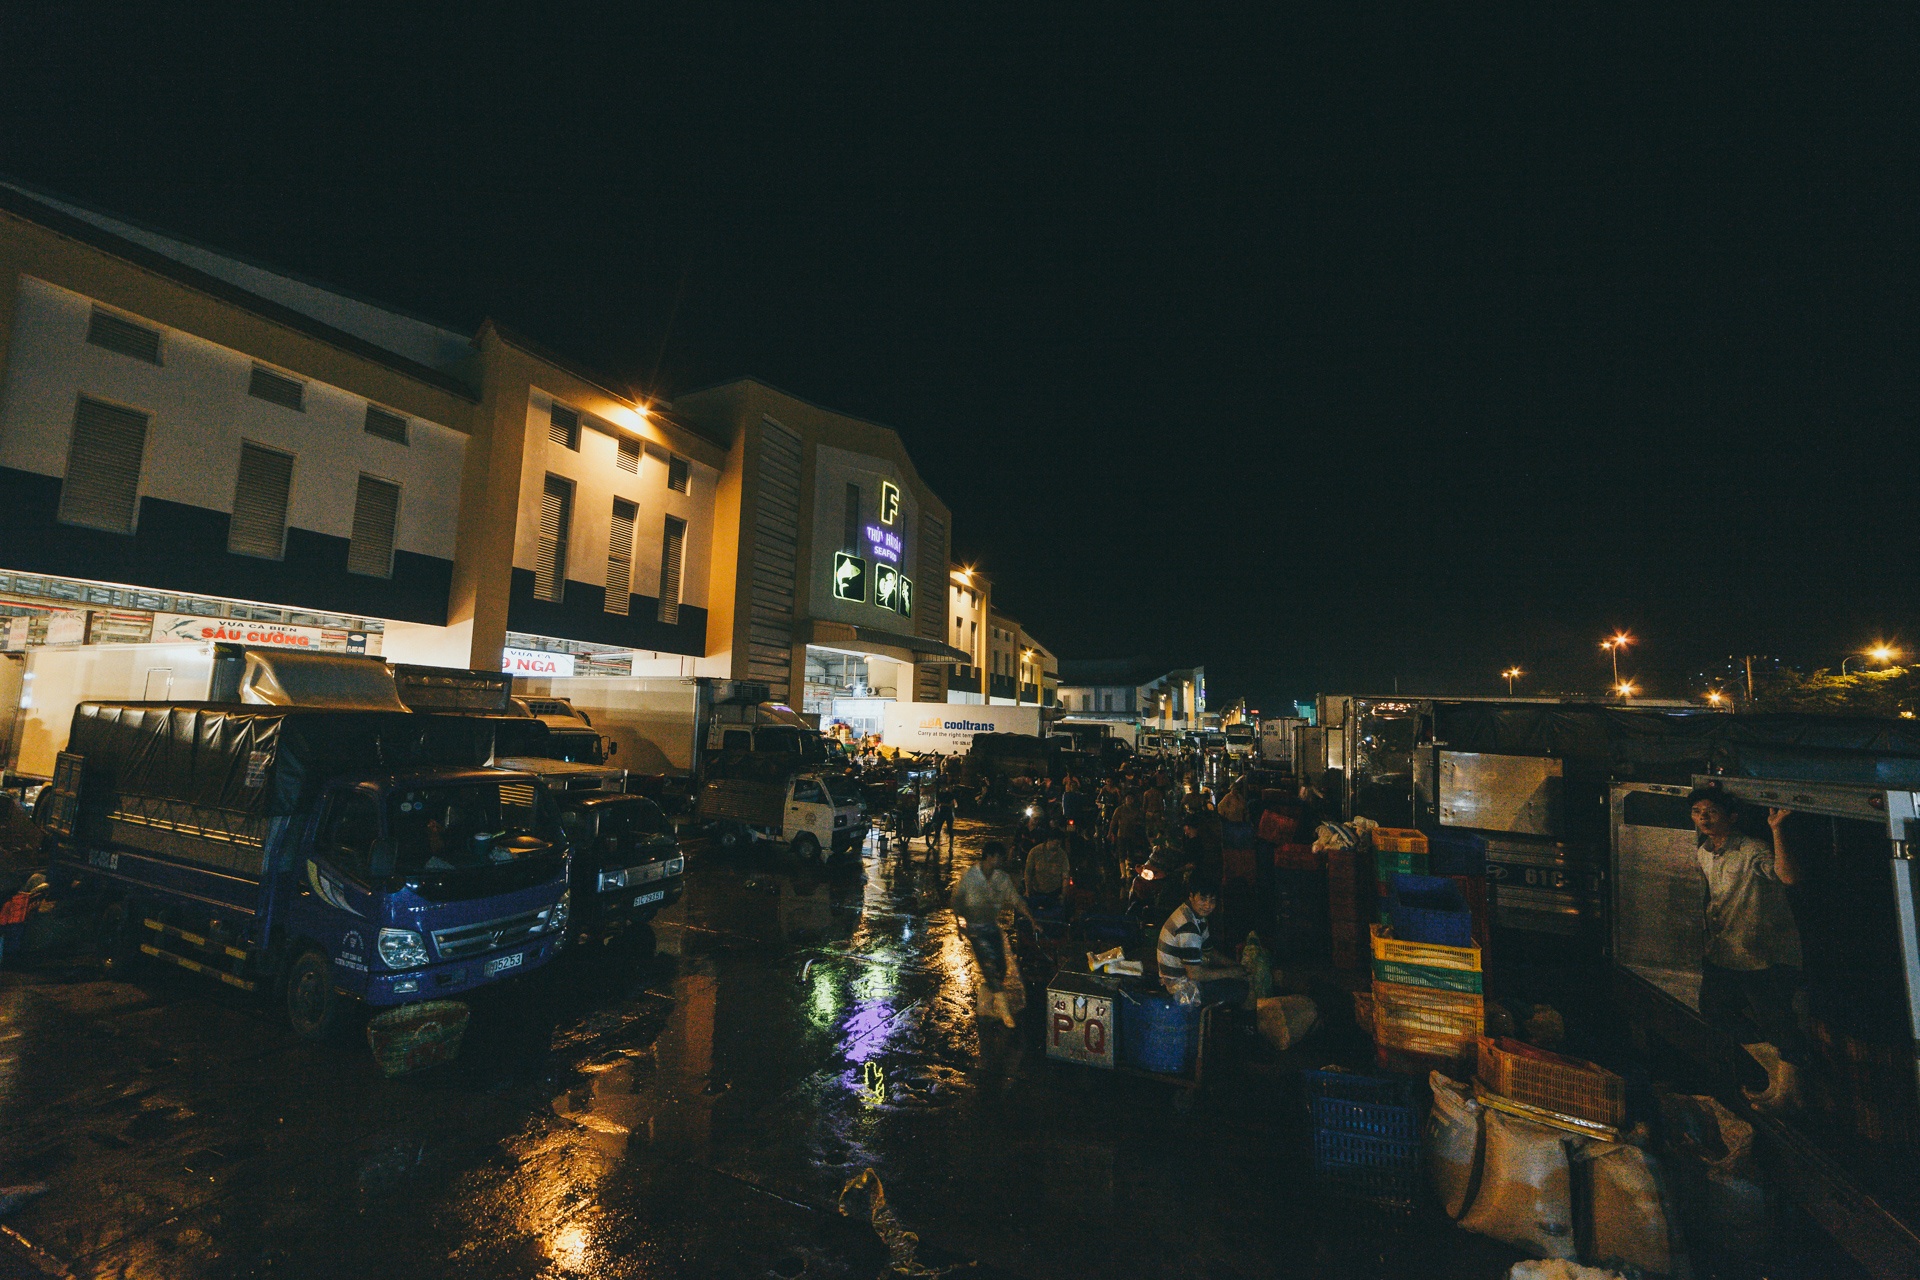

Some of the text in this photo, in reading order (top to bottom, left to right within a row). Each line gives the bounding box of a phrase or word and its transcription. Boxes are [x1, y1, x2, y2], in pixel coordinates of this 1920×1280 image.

[880, 480, 900, 526] F
[874, 546, 897, 562] SEAFOOD
[202, 627, 310, 646] SÁU CƯỜNG
[517, 658, 557, 672] NGA
[944, 720, 995, 731] cooltrans
[1054, 1000, 1106, 1017] 49 17
